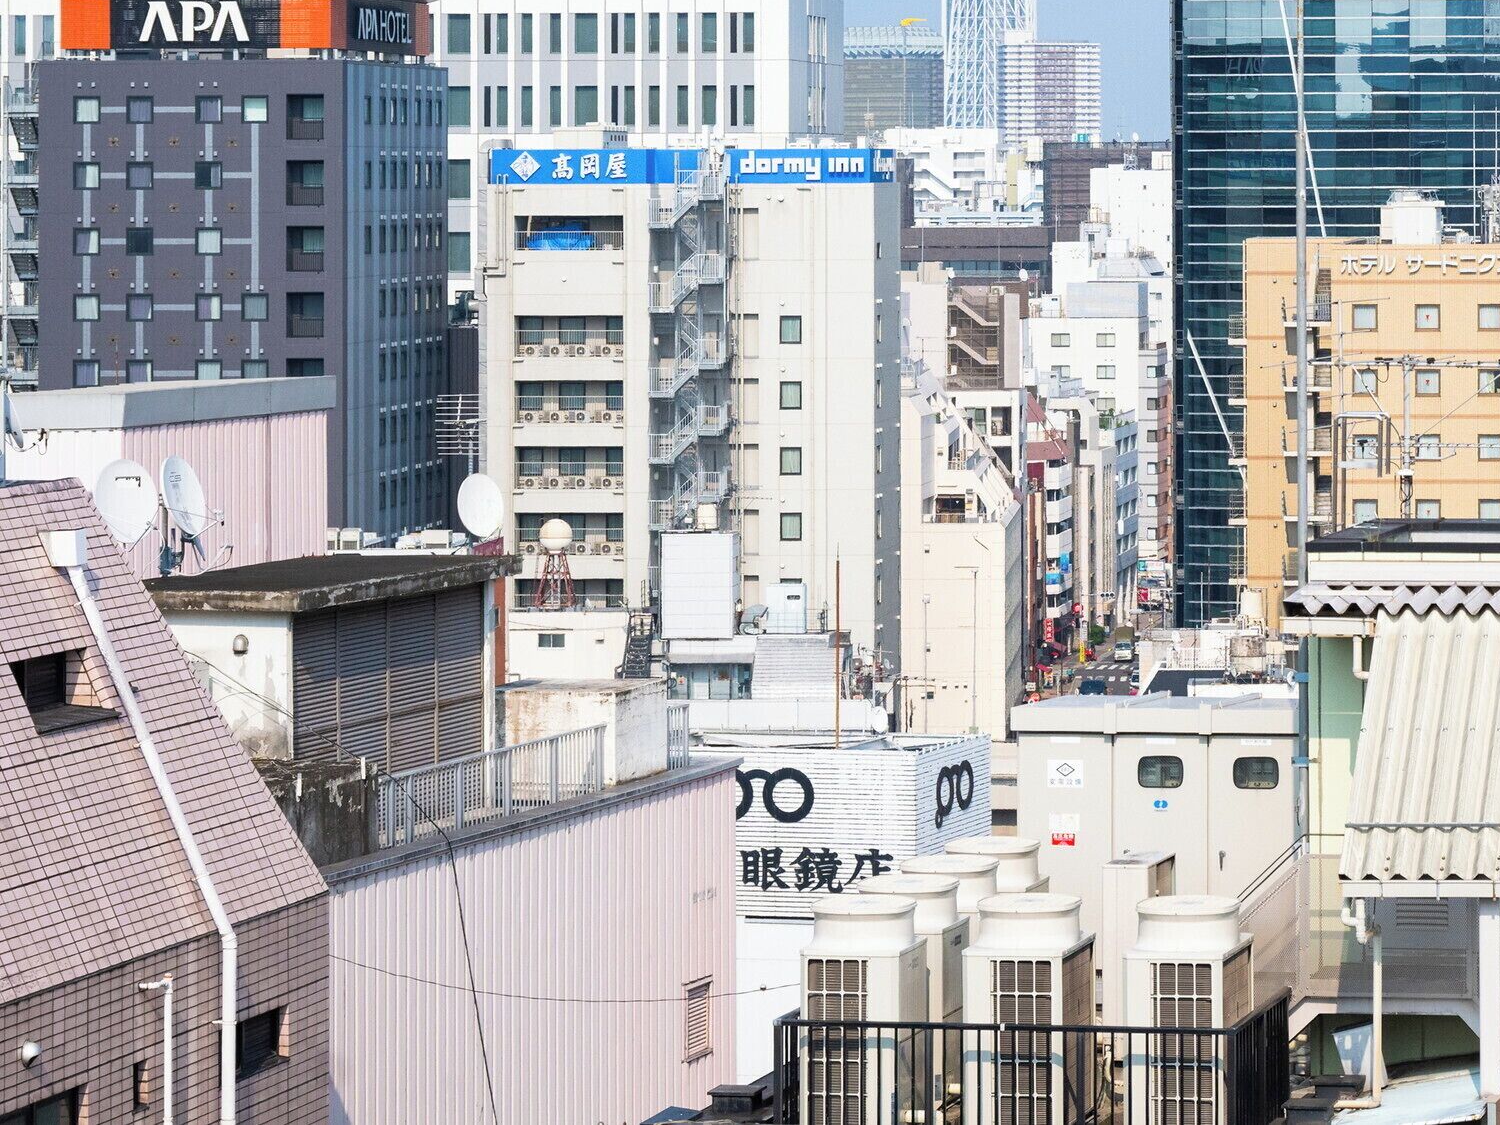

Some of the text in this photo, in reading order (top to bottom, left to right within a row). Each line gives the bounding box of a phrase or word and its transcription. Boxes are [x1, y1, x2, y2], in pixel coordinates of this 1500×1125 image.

[138, 1, 250, 42] APA
[358, 8, 412, 44] APA HOTEL
[739, 150, 864, 181] dormy inn
[1341, 255, 1396, 275] ホテル
